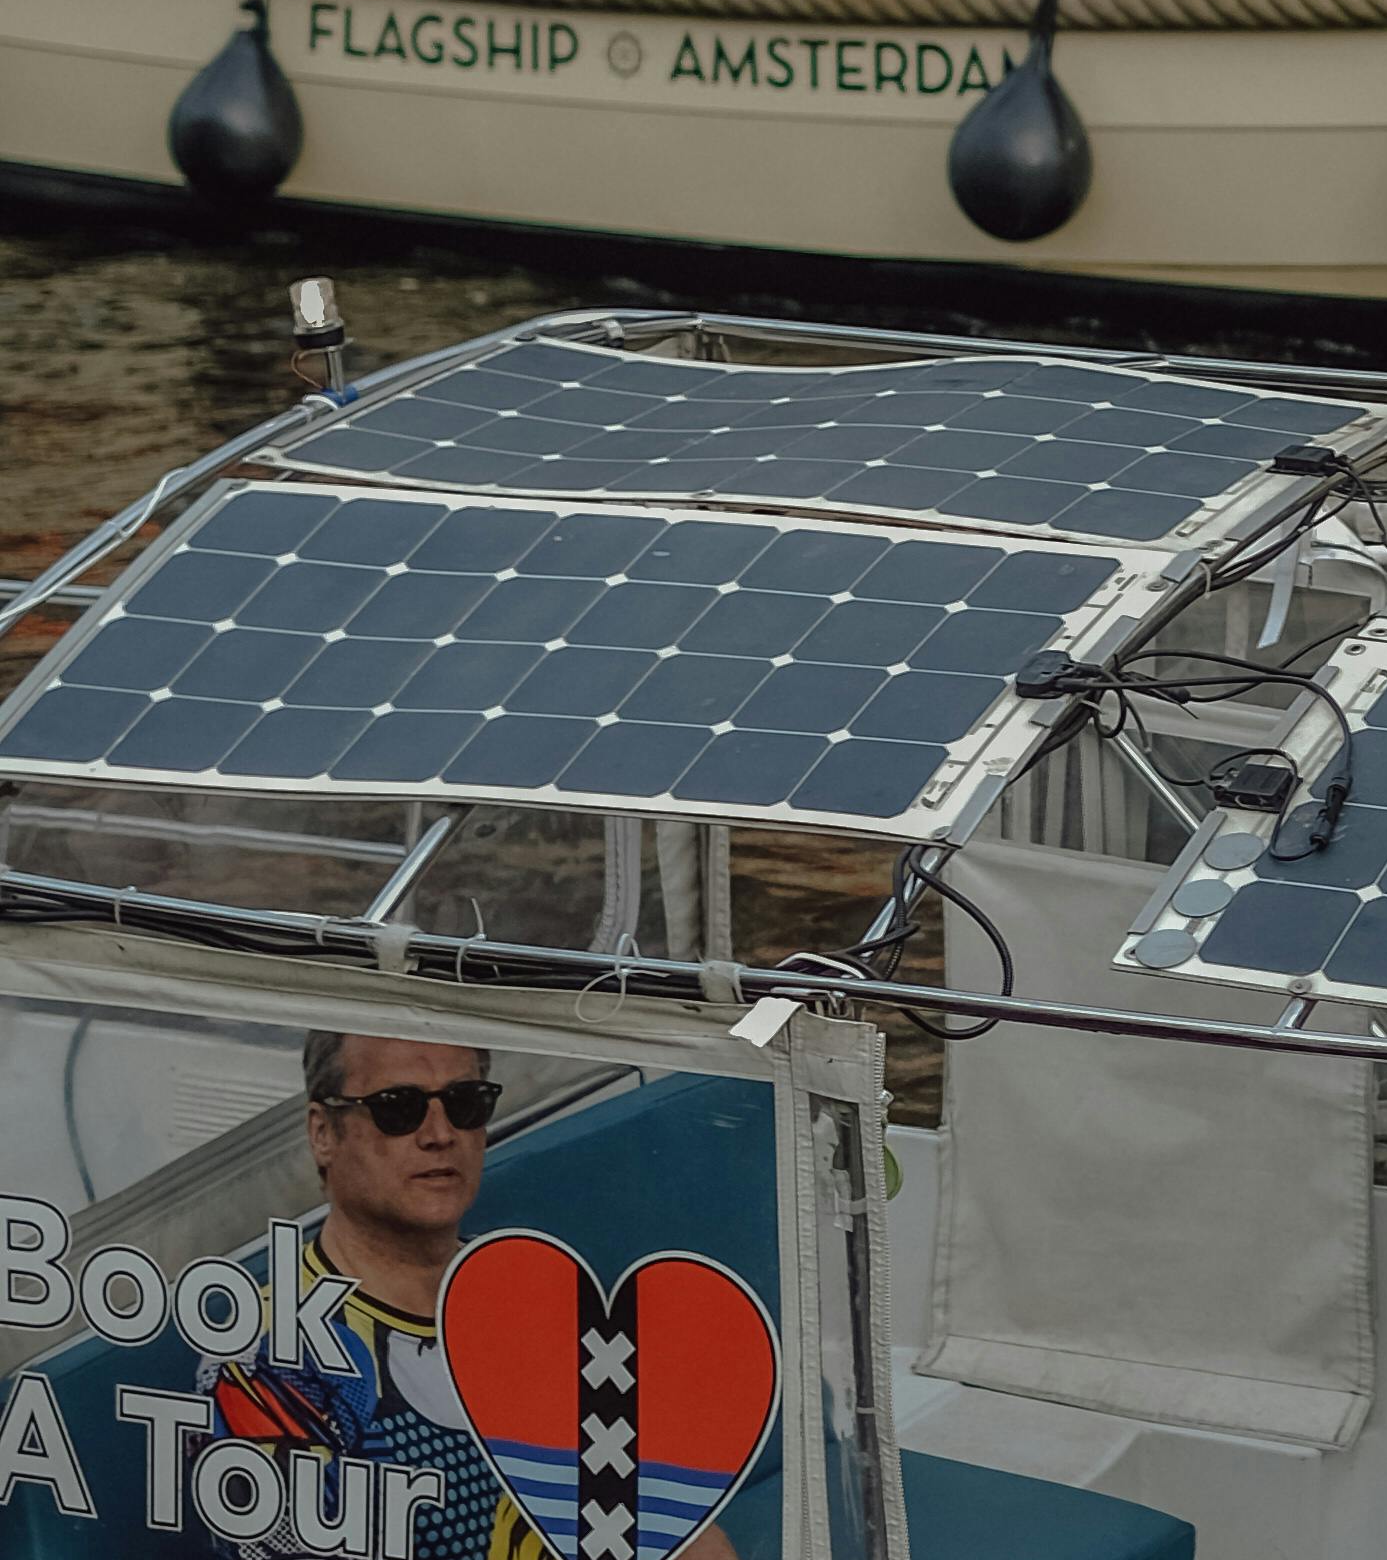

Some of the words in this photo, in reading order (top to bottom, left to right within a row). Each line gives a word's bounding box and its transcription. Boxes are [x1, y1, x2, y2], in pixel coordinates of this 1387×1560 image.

[307, 2, 580, 74] FLAGSHIP
[0, 1192, 363, 1378] Book
[0, 1372, 98, 1520] A
